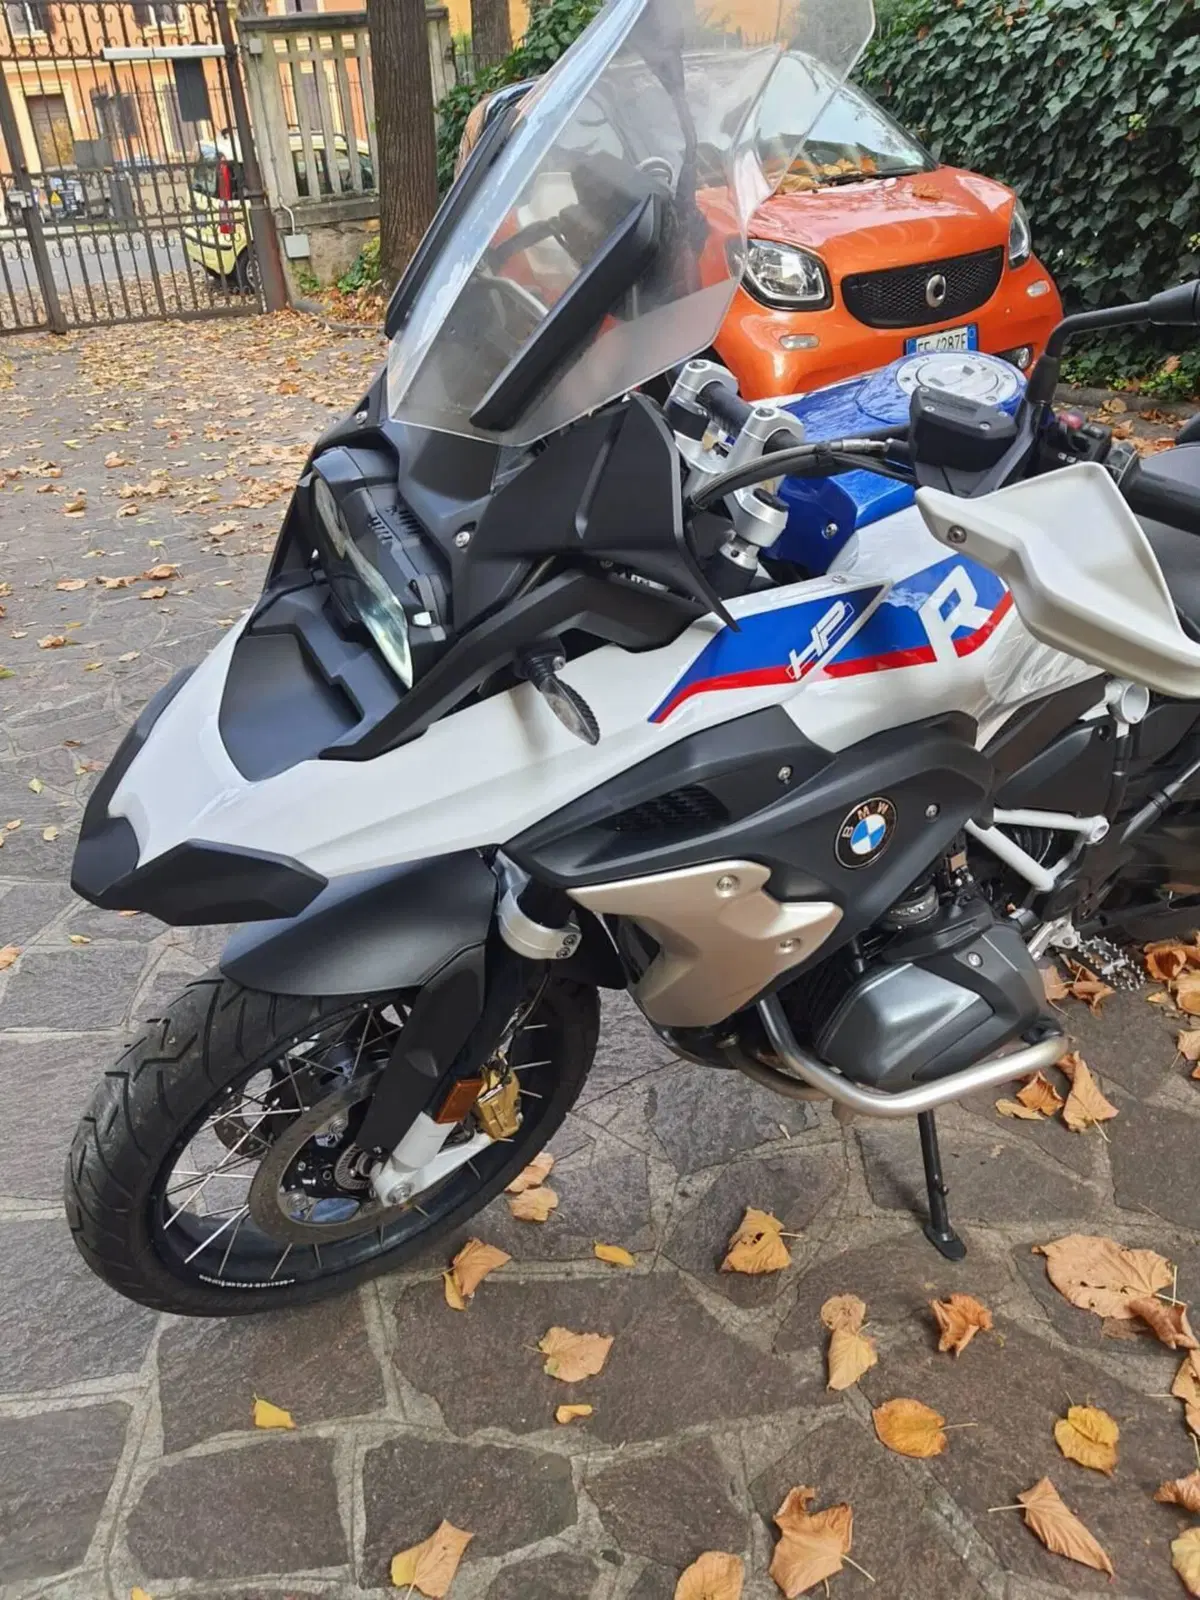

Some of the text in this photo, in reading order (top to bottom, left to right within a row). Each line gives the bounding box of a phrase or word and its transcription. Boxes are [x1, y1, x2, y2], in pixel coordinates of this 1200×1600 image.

[787, 600, 854, 680] HP
[918, 565, 995, 662] R
[841, 801, 889, 838] BMW
